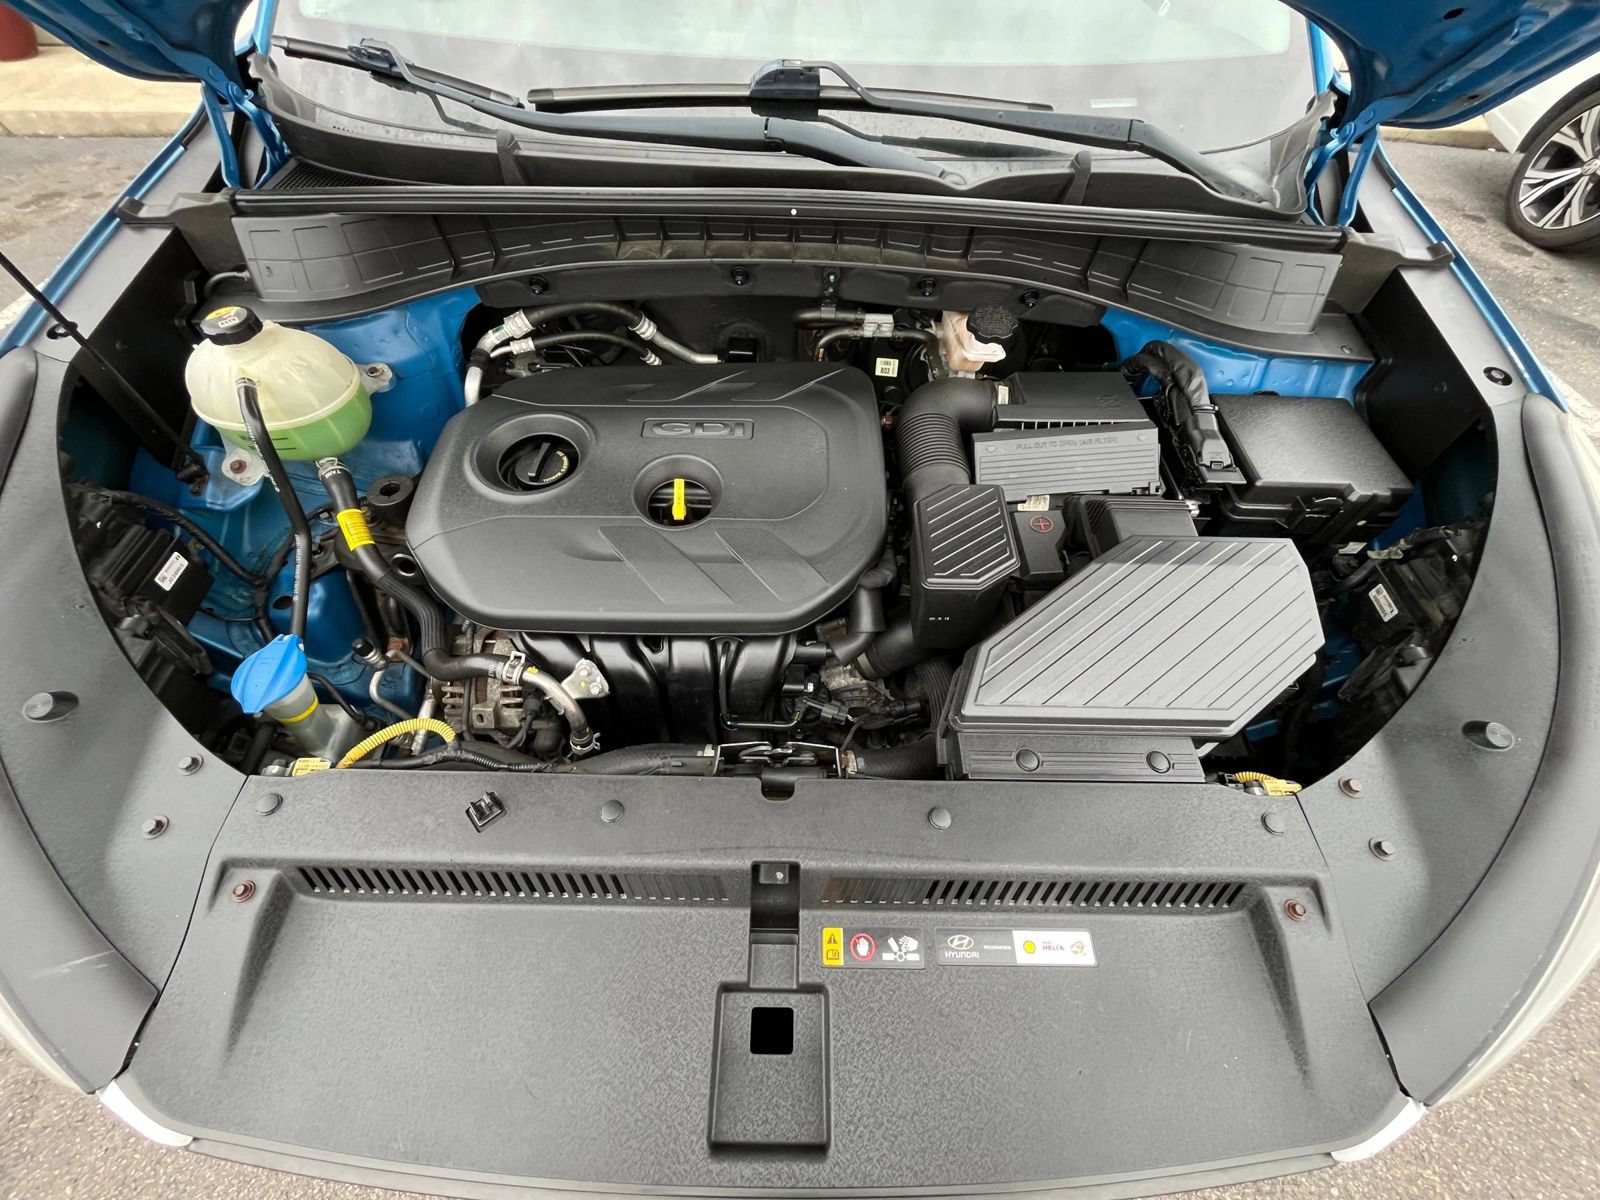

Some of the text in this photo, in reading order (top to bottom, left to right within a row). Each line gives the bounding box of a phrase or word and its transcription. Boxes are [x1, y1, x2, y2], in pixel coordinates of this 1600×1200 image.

[651, 422, 745, 437] GDI
[1049, 440, 1058, 448] TO
[1042, 944, 1065, 952] HELIX
[945, 951, 979, 959] HYUNDAI
